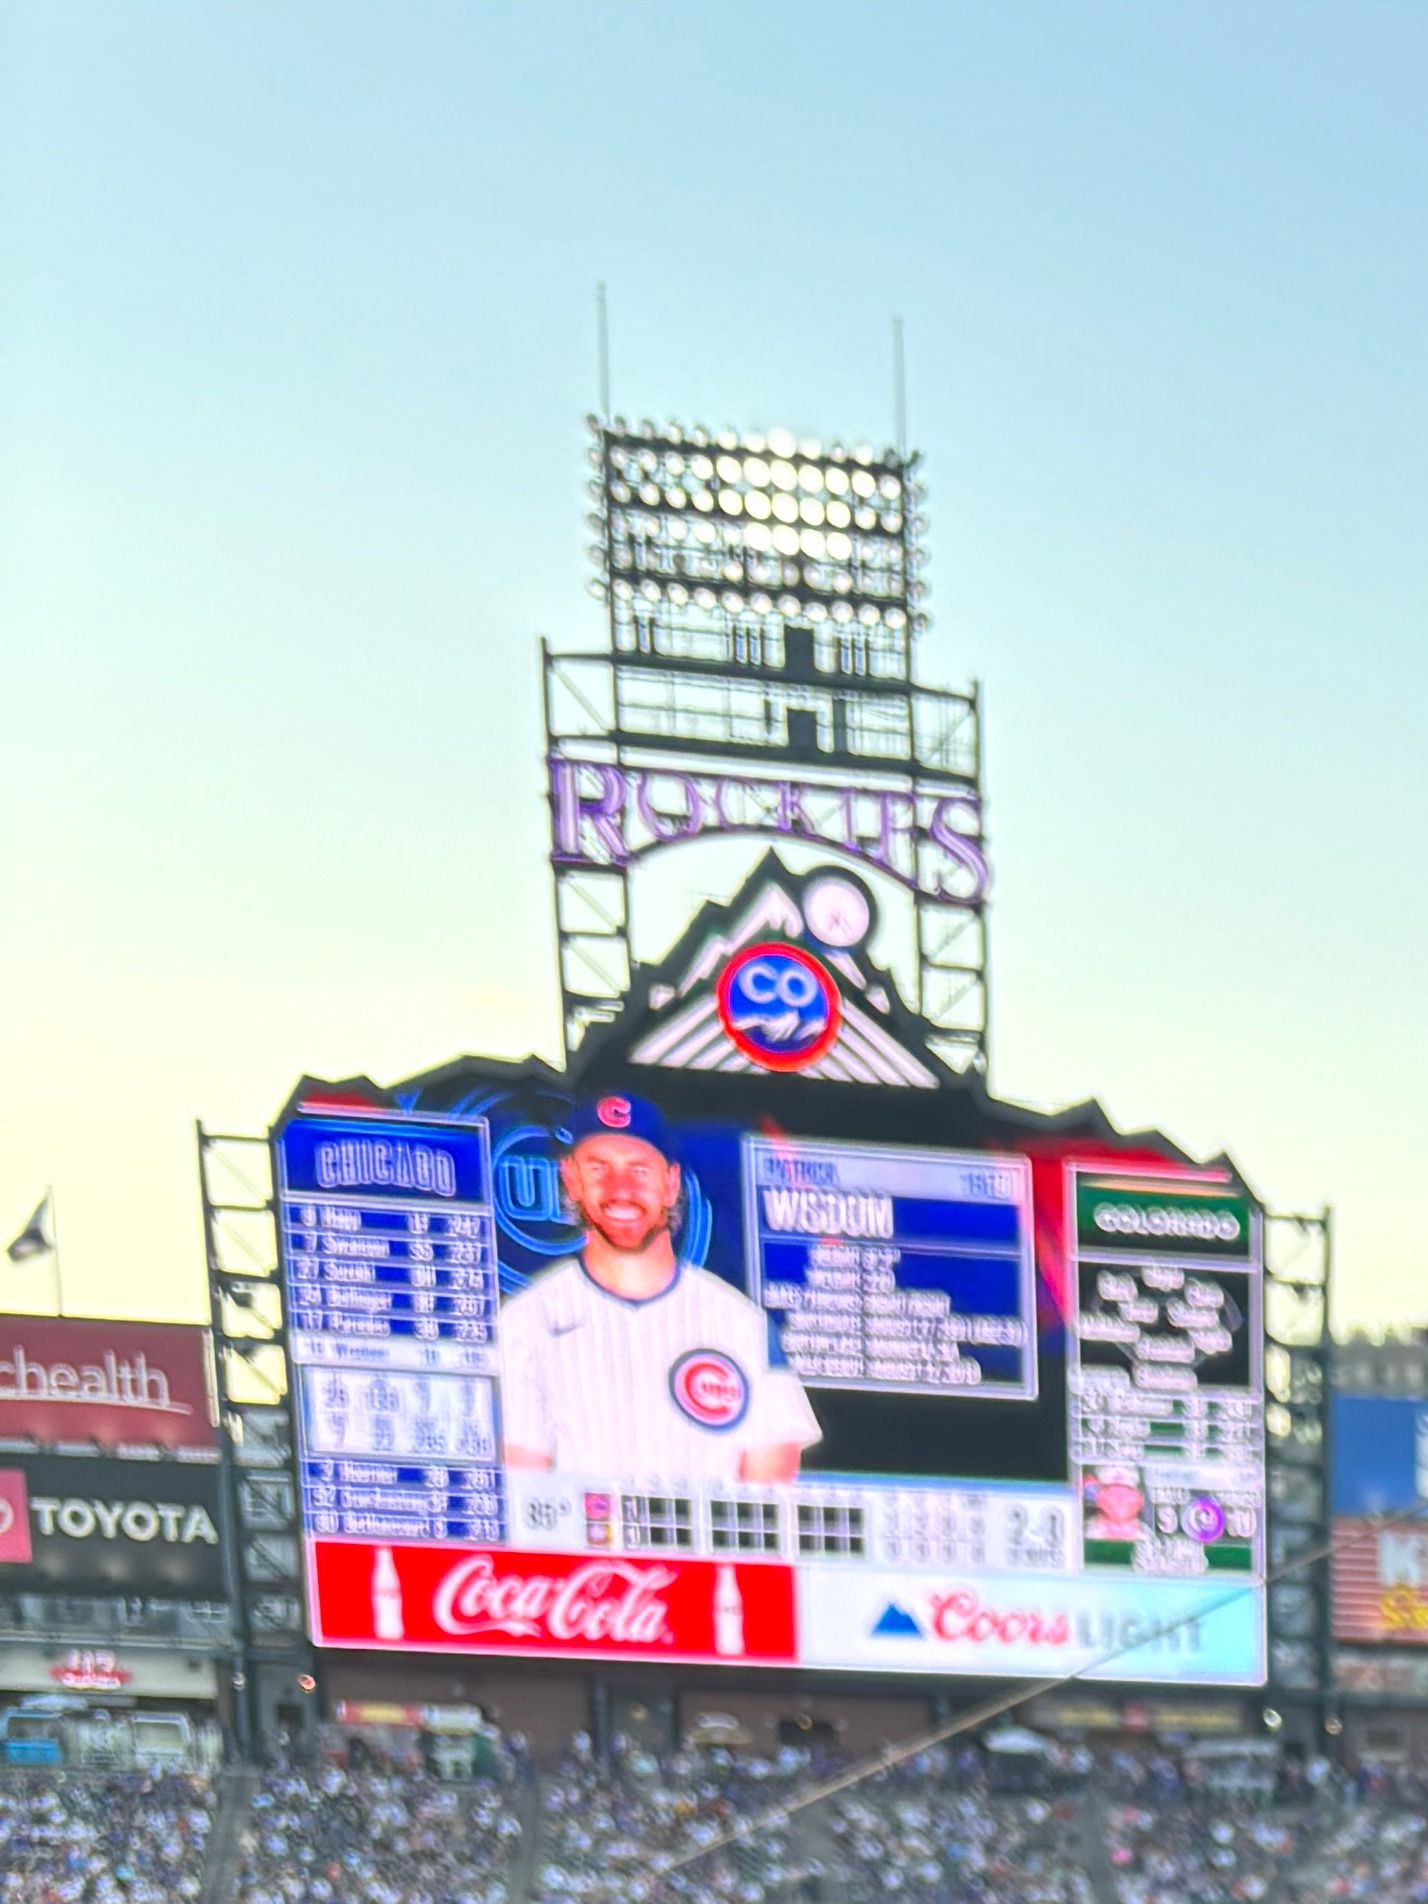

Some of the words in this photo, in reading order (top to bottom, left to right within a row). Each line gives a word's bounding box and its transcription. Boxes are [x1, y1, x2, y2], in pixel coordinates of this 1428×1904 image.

[549, 757, 989, 904] ROCKIES
[315, 1138, 457, 1197] CHICAGO
[31, 1498, 220, 1546] TOYOTA
[433, 1553, 678, 1646] Coca-Cola
[929, 1591, 1070, 1647] Coors
